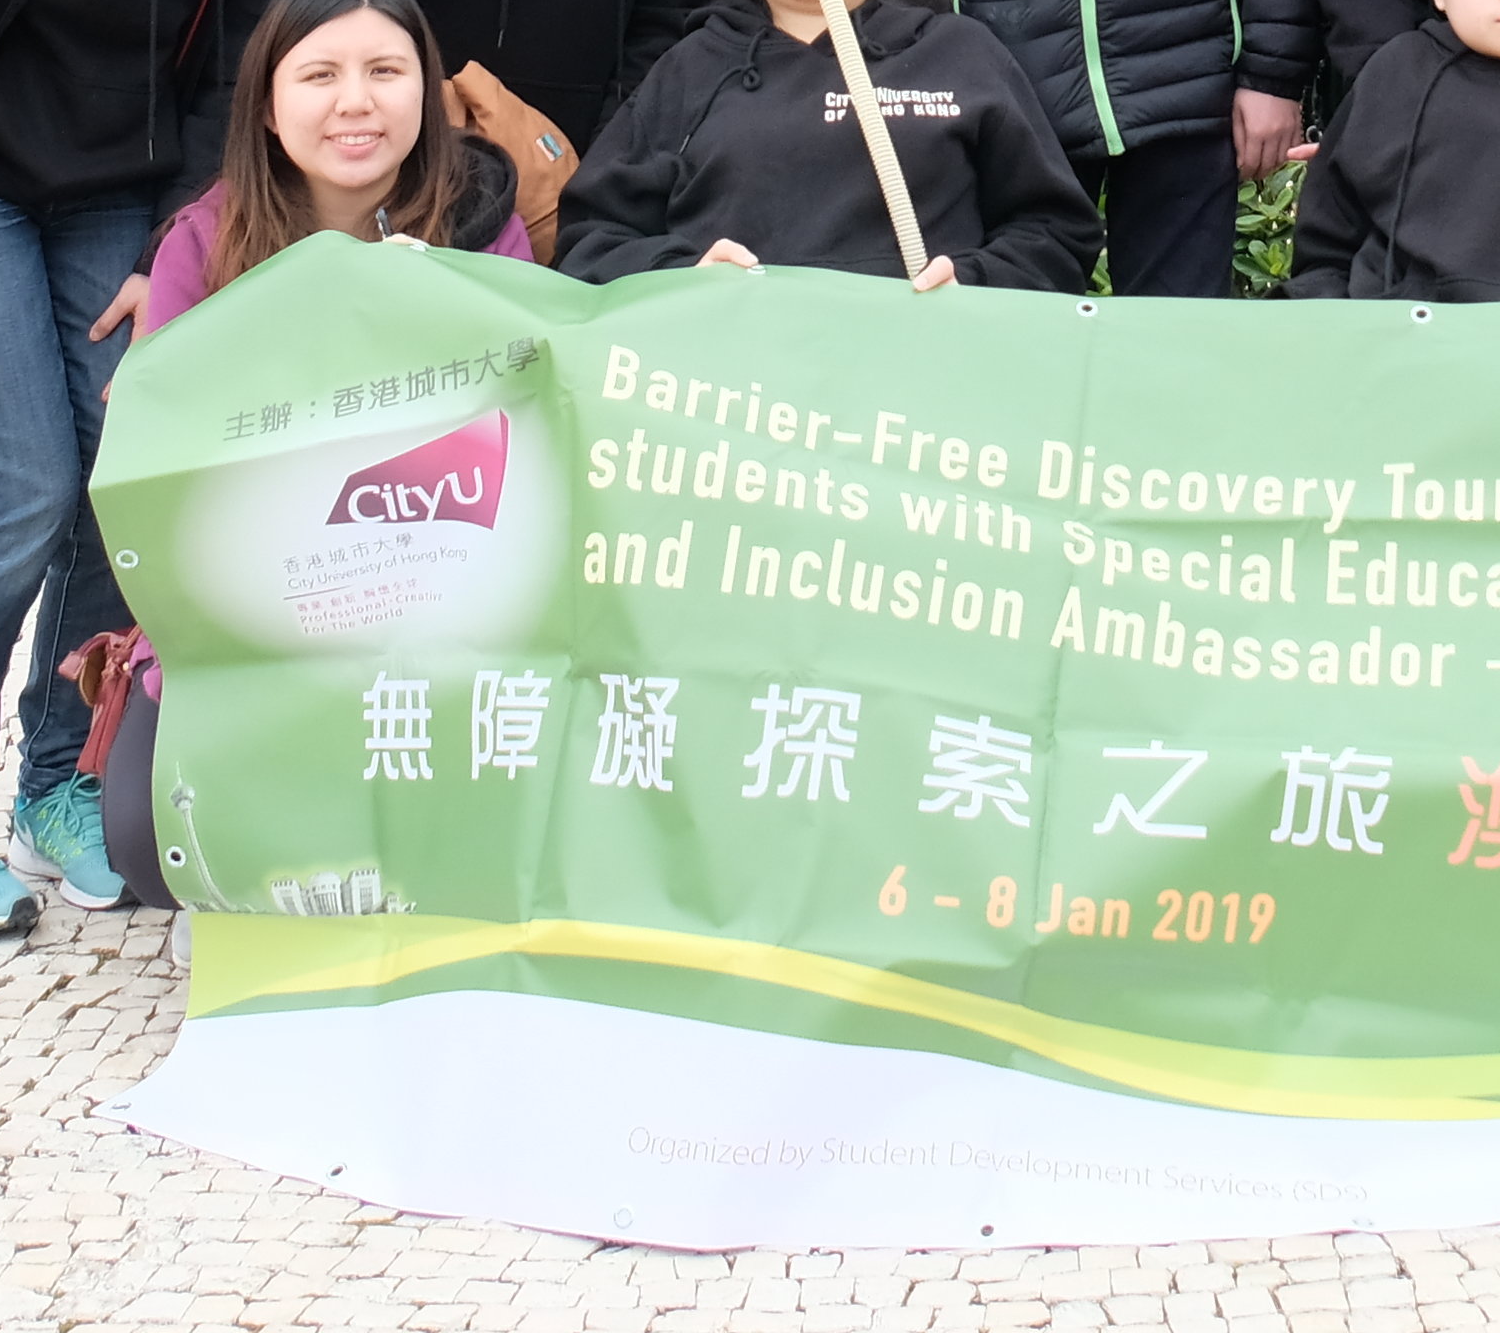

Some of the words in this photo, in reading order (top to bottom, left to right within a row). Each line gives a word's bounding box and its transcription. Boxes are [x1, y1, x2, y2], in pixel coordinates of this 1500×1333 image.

[823, 108, 846, 122] OF
[913, 103, 961, 118] KONG
[825, 91, 851, 107] CIT
[602, 344, 1009, 488] Barrier-Free
[1037, 440, 1356, 534] Discovery
[347, 466, 483, 523] CityU
[586, 428, 870, 520] students
[900, 491, 1032, 553] with
[288, 577, 315, 589] City
[317, 561, 382, 584] University
[384, 554, 397, 569] of
[401, 550, 438, 564] Hong
[440, 545, 468, 562] Kong
[361, 606, 403, 625] World
[583, 520, 695, 590] and
[720, 524, 1025, 640] Inclusion
[1050, 586, 1456, 687] Ambassador
[878, 865, 907, 917] 6
[986, 875, 1017, 929] 8
[1034, 883, 1131, 939] Jan
[1152, 888, 1276, 945] 2019
[628, 1126, 771, 1166] Organized
[779, 1139, 814, 1171] by
[819, 1137, 940, 1166] Student
[949, 1140, 1155, 1183] Development
[1163, 1165, 1283, 1200] Services
